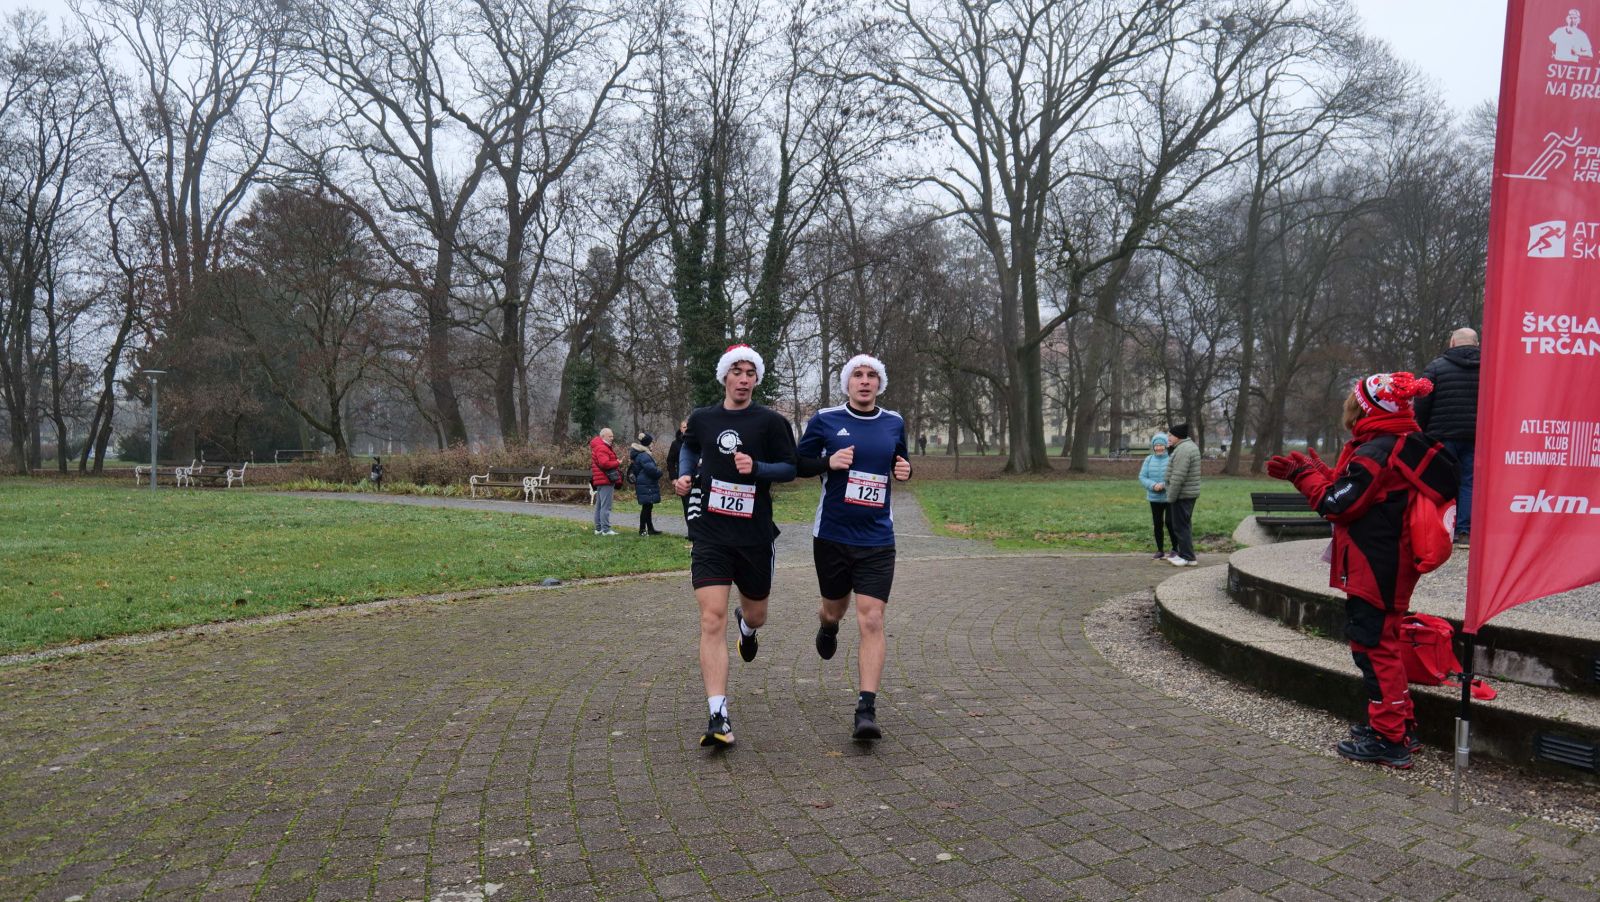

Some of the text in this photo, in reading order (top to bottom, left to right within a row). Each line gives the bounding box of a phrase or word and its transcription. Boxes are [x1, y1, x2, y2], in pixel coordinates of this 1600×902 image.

[1546, 63, 1591, 81] SVETI
[1545, 80, 1567, 97] NA
[1572, 239, 1600, 260] ŠK
[1522, 311, 1600, 334] ŠKOLA
[1520, 419, 1571, 435] ATLETSKI
[1544, 436, 1569, 451] KLUB
[1504, 451, 1568, 466] MEĐIMURJE
[858, 486, 880, 502] 125
[720, 495, 744, 511] 126
